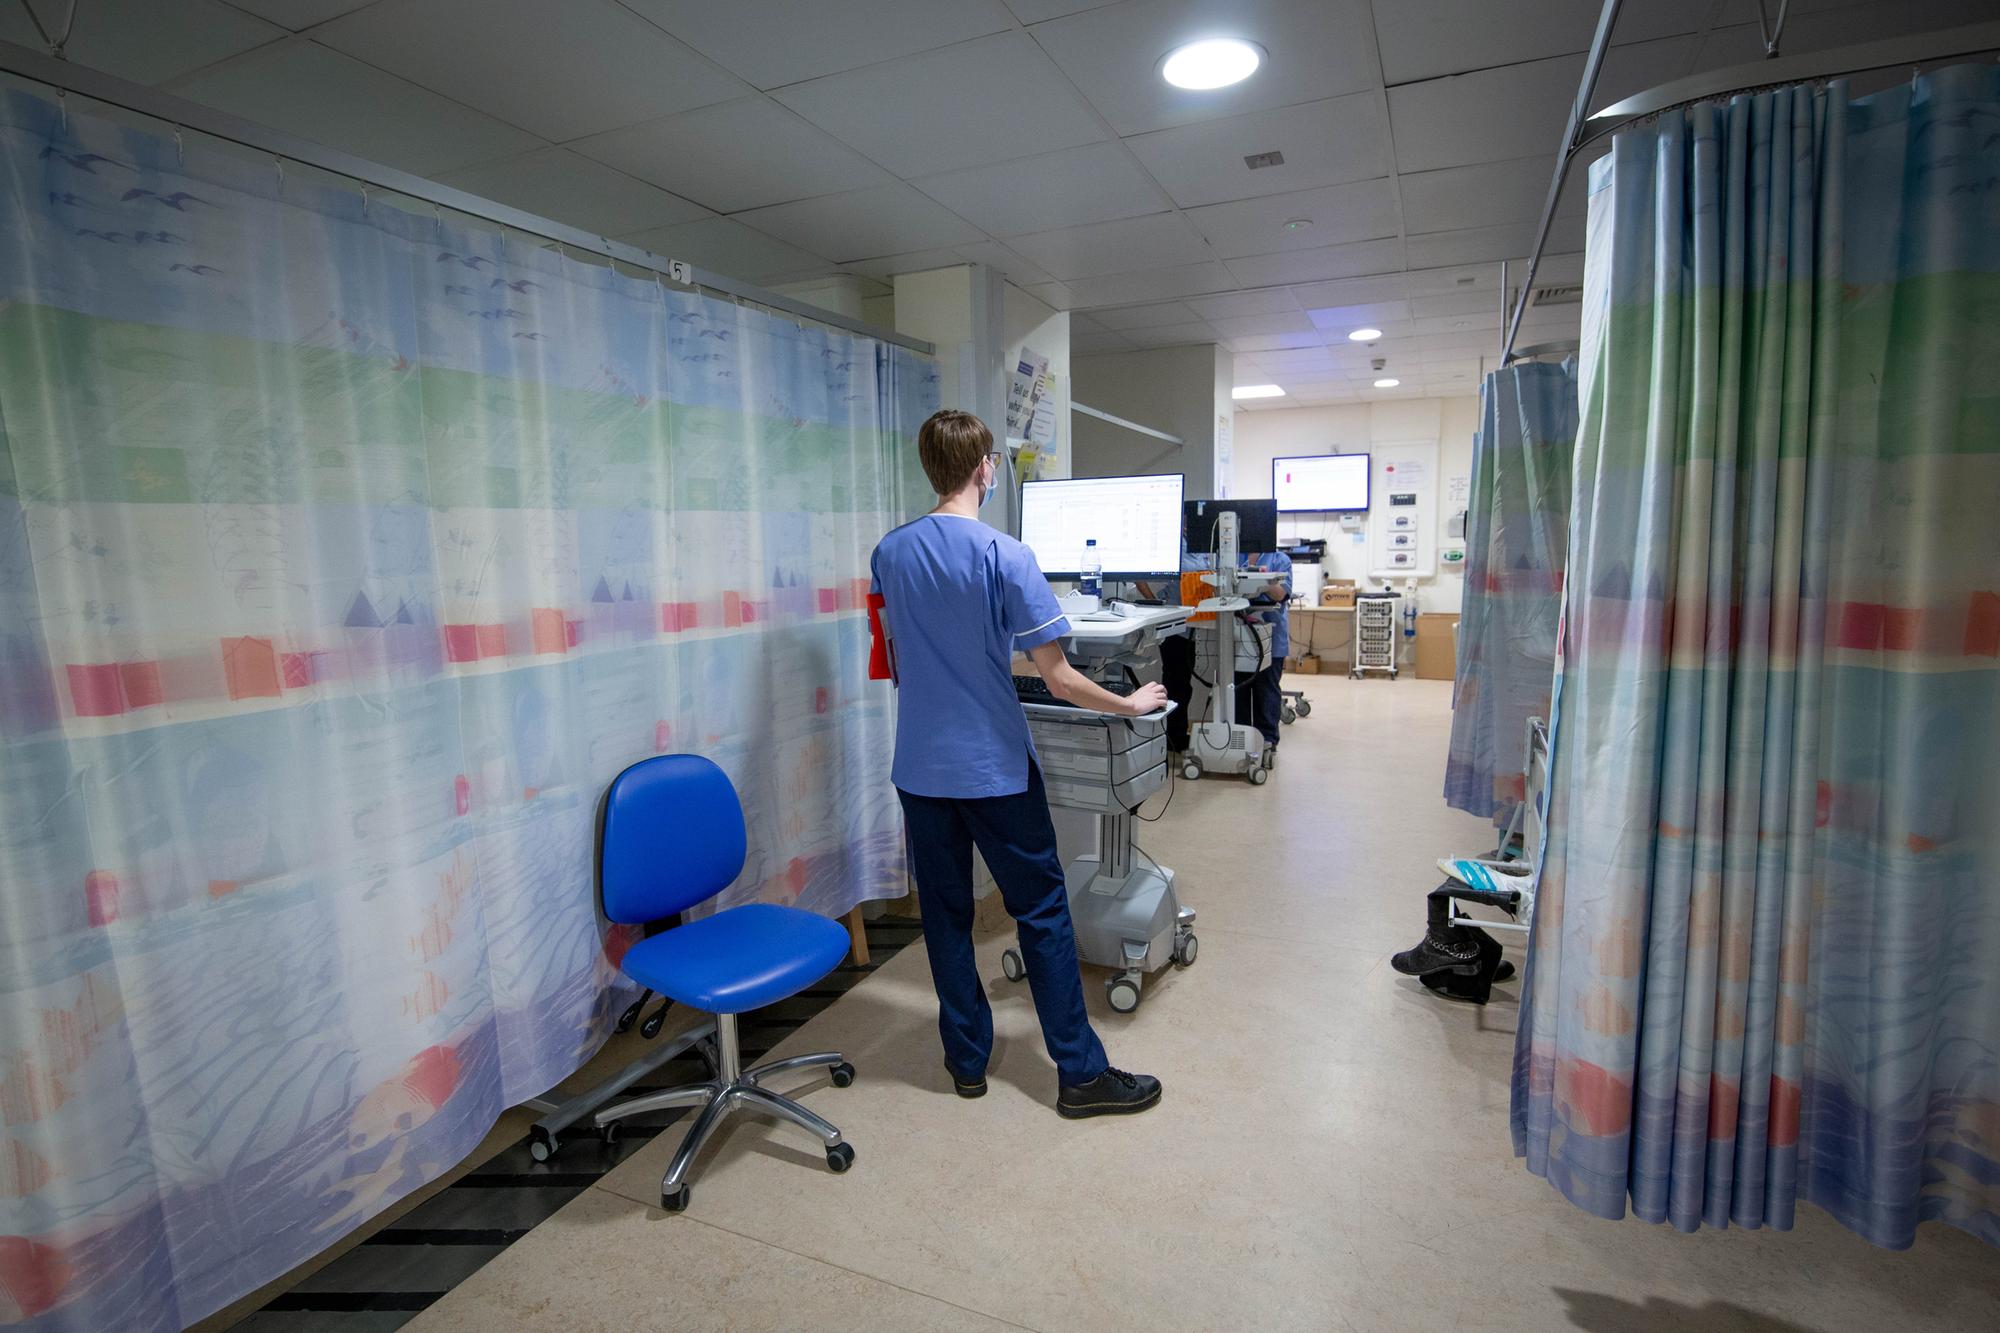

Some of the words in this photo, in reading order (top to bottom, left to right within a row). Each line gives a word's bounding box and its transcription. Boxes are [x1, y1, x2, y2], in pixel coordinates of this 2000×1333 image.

[673, 262, 683, 281] 5
[1013, 382, 1023, 395] Tell
[1008, 399, 1022, 413] what
